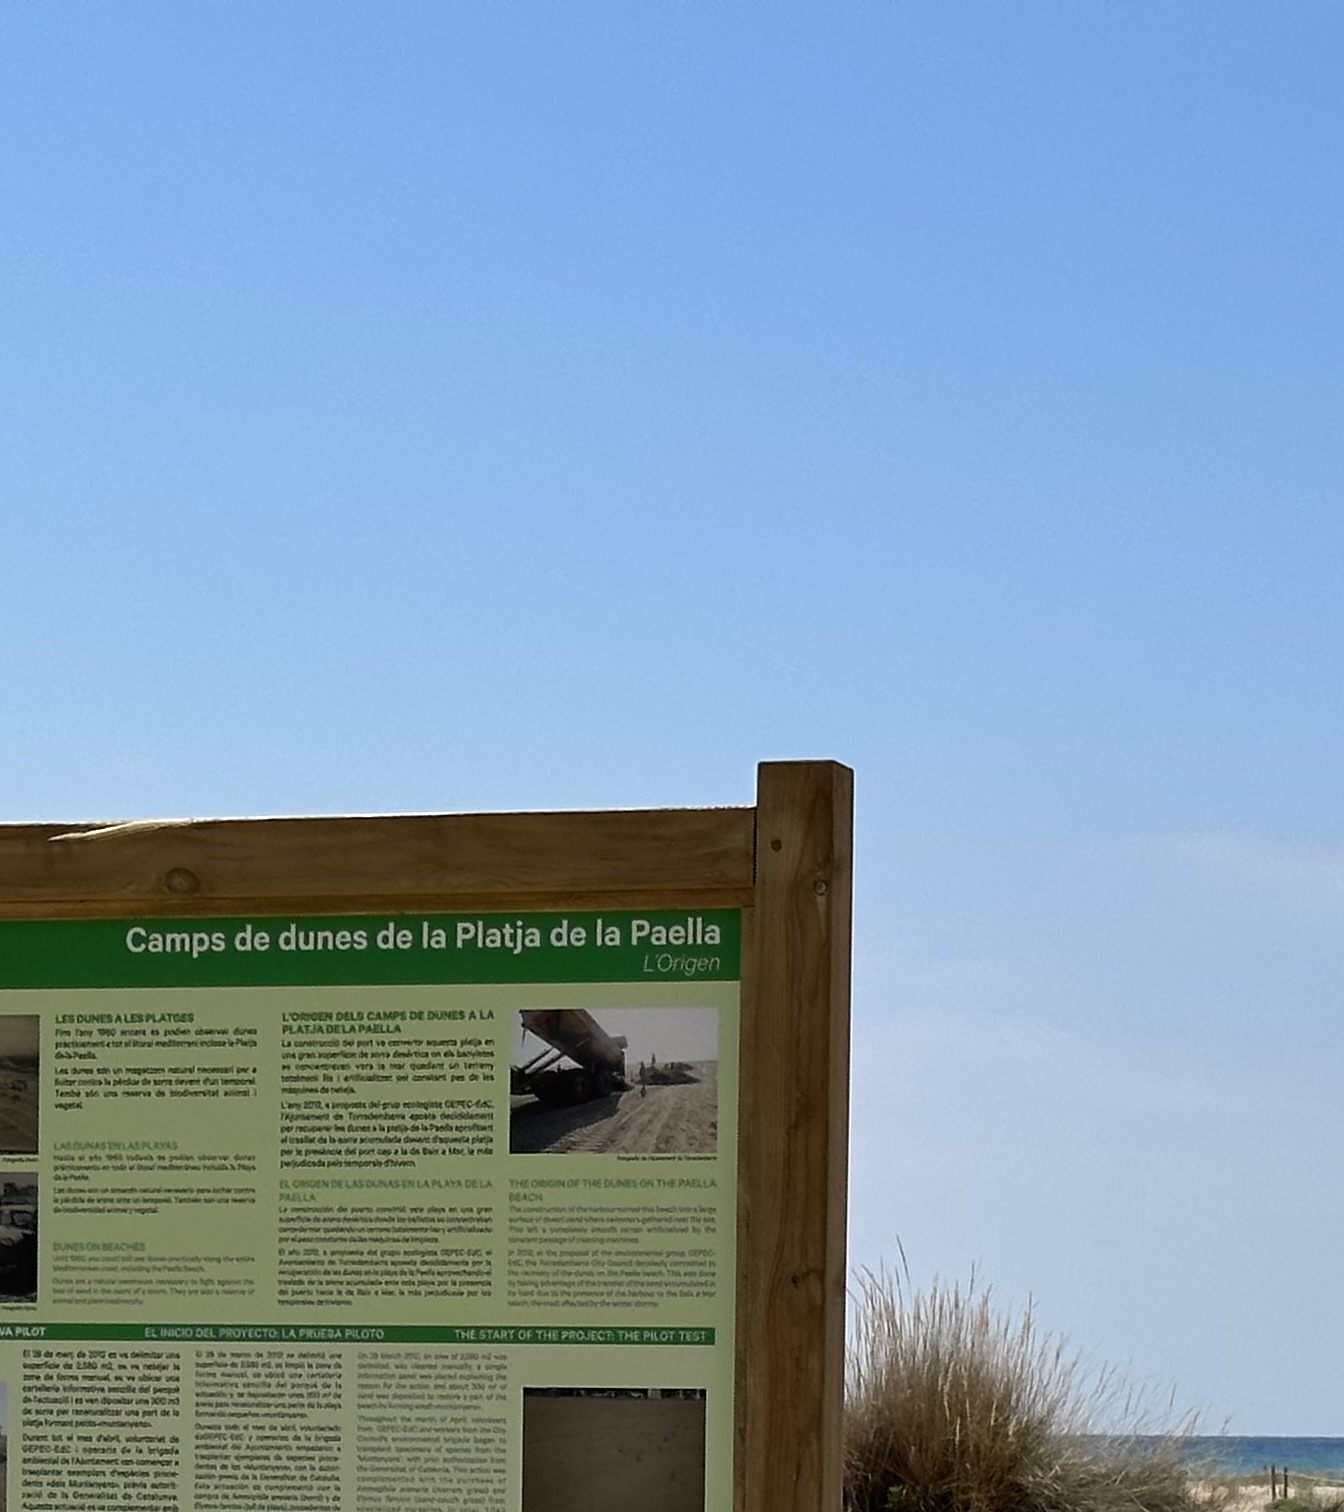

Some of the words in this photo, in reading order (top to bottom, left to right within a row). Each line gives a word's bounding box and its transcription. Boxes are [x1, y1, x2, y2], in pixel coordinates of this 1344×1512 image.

[125, 927, 226, 958] Camps
[234, 924, 270, 951] de
[278, 923, 368, 951] dunes
[376, 922, 413, 950] de
[422, 921, 446, 949] la
[456, 920, 541, 954] Platja
[550, 919, 586, 947] de
[596, 919, 621, 946] la
[630, 917, 721, 946] Paella
[643, 953, 721, 976] L'Origen
[55, 1014, 74, 1024] LES
[76, 1013, 113, 1023] DUNES
[114, 1013, 122, 1023] A
[124, 1013, 143, 1023] LES
[144, 1012, 194, 1022] PLATGES
[282, 1011, 332, 1022] L'ORIGEN
[336, 1011, 364, 1021] DELS
[366, 1010, 406, 1021] CAMPS
[409, 1010, 424, 1020] DE
[427, 1009, 465, 1020] DUNES
[468, 1009, 476, 1019] A
[479, 1009, 494, 1019] LA
[282, 1024, 324, 1034] PLATJA
[325, 1024, 340, 1034] DE
[342, 1023, 356, 1033] LA
[358, 1023, 401, 1033] PAELLA
[509, 1179, 528, 1188] THE
[530, 1178, 565, 1188] ORIGIN
[566, 1178, 579, 1188] OF
[582, 1178, 601, 1188] THE
[604, 1178, 637, 1188] DUNES
[639, 1178, 654, 1188] ON
[655, 1178, 676, 1188] THE
[678, 1178, 717, 1188] PAELLA
[279, 1193, 316, 1202] PAELLA
[15, 1327, 46, 1337] PILOT
[145, 1328, 158, 1338] EL
[161, 1328, 193, 1338] INICIO
[195, 1328, 216, 1338] DEL
[219, 1328, 279, 1338] PROYECTO:
[282, 1329, 296, 1339] LA
[299, 1329, 342, 1339] PRUEBA
[345, 1329, 384, 1339] PILOTO
[454, 1329, 475, 1339] THE
[480, 1329, 514, 1340] START
[518, 1330, 533, 1340] OF
[536, 1330, 557, 1340] THE
[561, 1330, 613, 1340] PROJECT:
[619, 1331, 639, 1341] THE
[642, 1331, 674, 1341] PILOT
[678, 1331, 706, 1341] TEST
